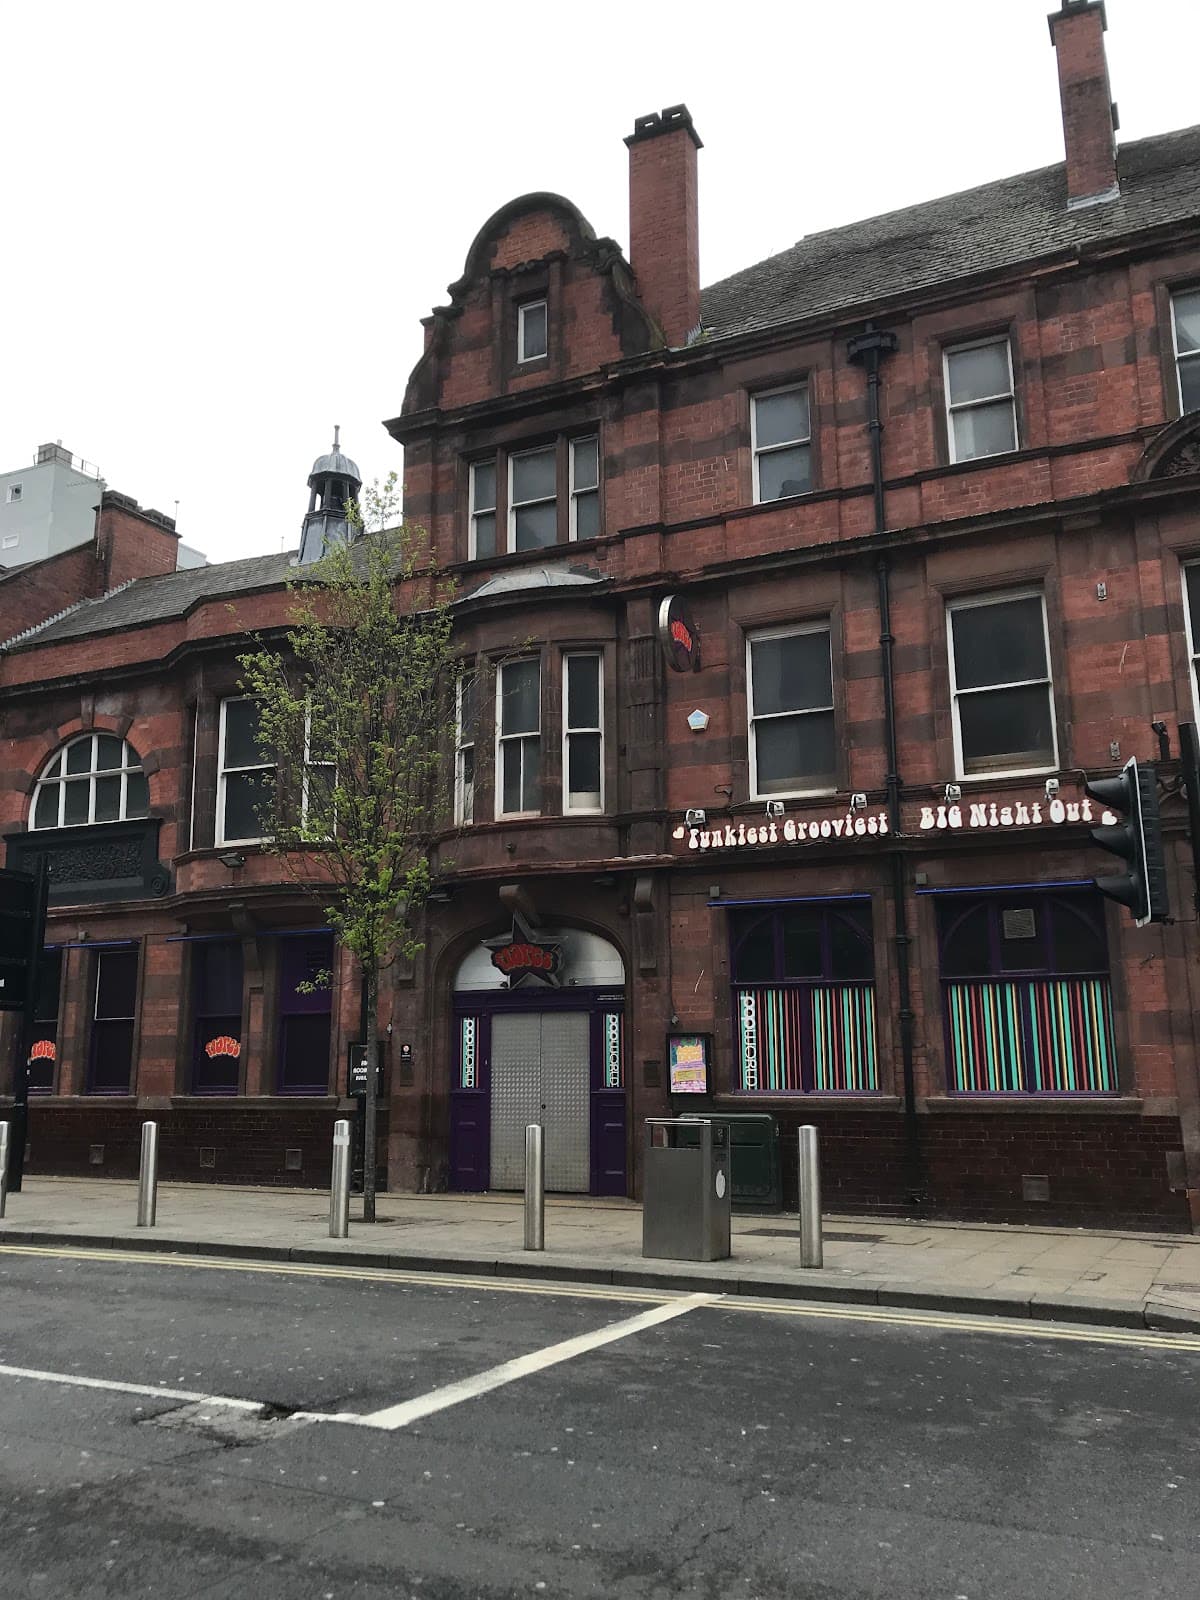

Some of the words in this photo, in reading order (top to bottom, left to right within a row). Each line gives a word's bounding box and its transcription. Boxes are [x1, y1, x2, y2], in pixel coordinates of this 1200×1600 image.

[687, 822, 779, 849] Funkiest
[783, 812, 889, 841] Grooviest
[919, 806, 963, 830] BIG
[969, 801, 1043, 828] Night
[1048, 797, 1093, 825] Out
